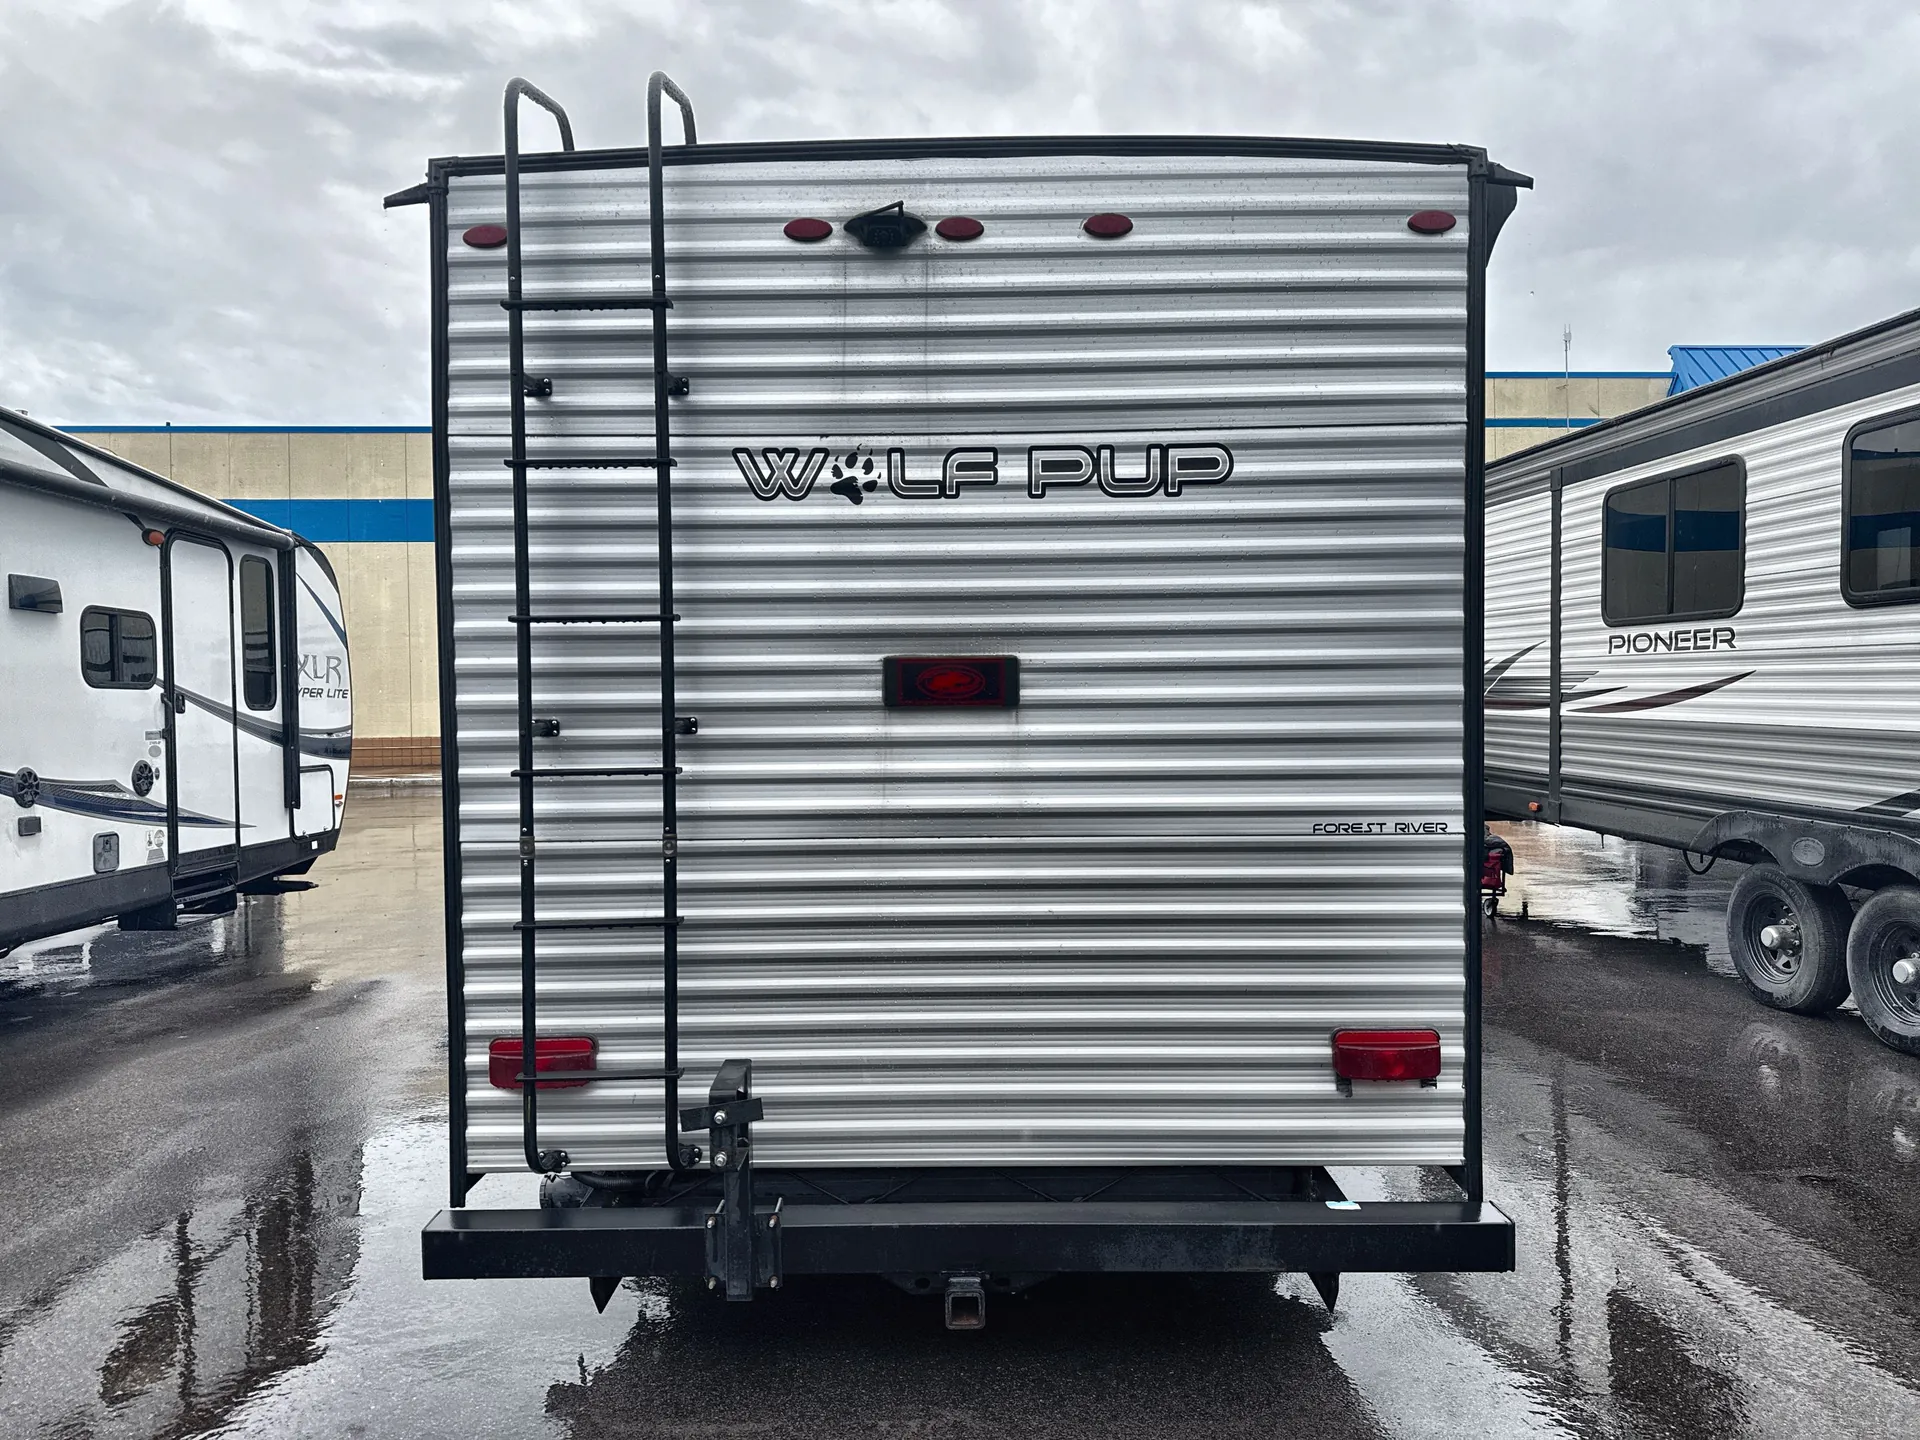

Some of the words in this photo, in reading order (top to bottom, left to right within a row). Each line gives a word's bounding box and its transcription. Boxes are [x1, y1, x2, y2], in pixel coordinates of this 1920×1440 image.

[1028, 443, 1234, 498] PUP
[1608, 626, 1737, 654] PIONEER
[298, 654, 342, 687] XLR
[327, 688, 349, 699] LITE
[1312, 823, 1387, 834] FOREST
[1395, 822, 1448, 833] RIVER
